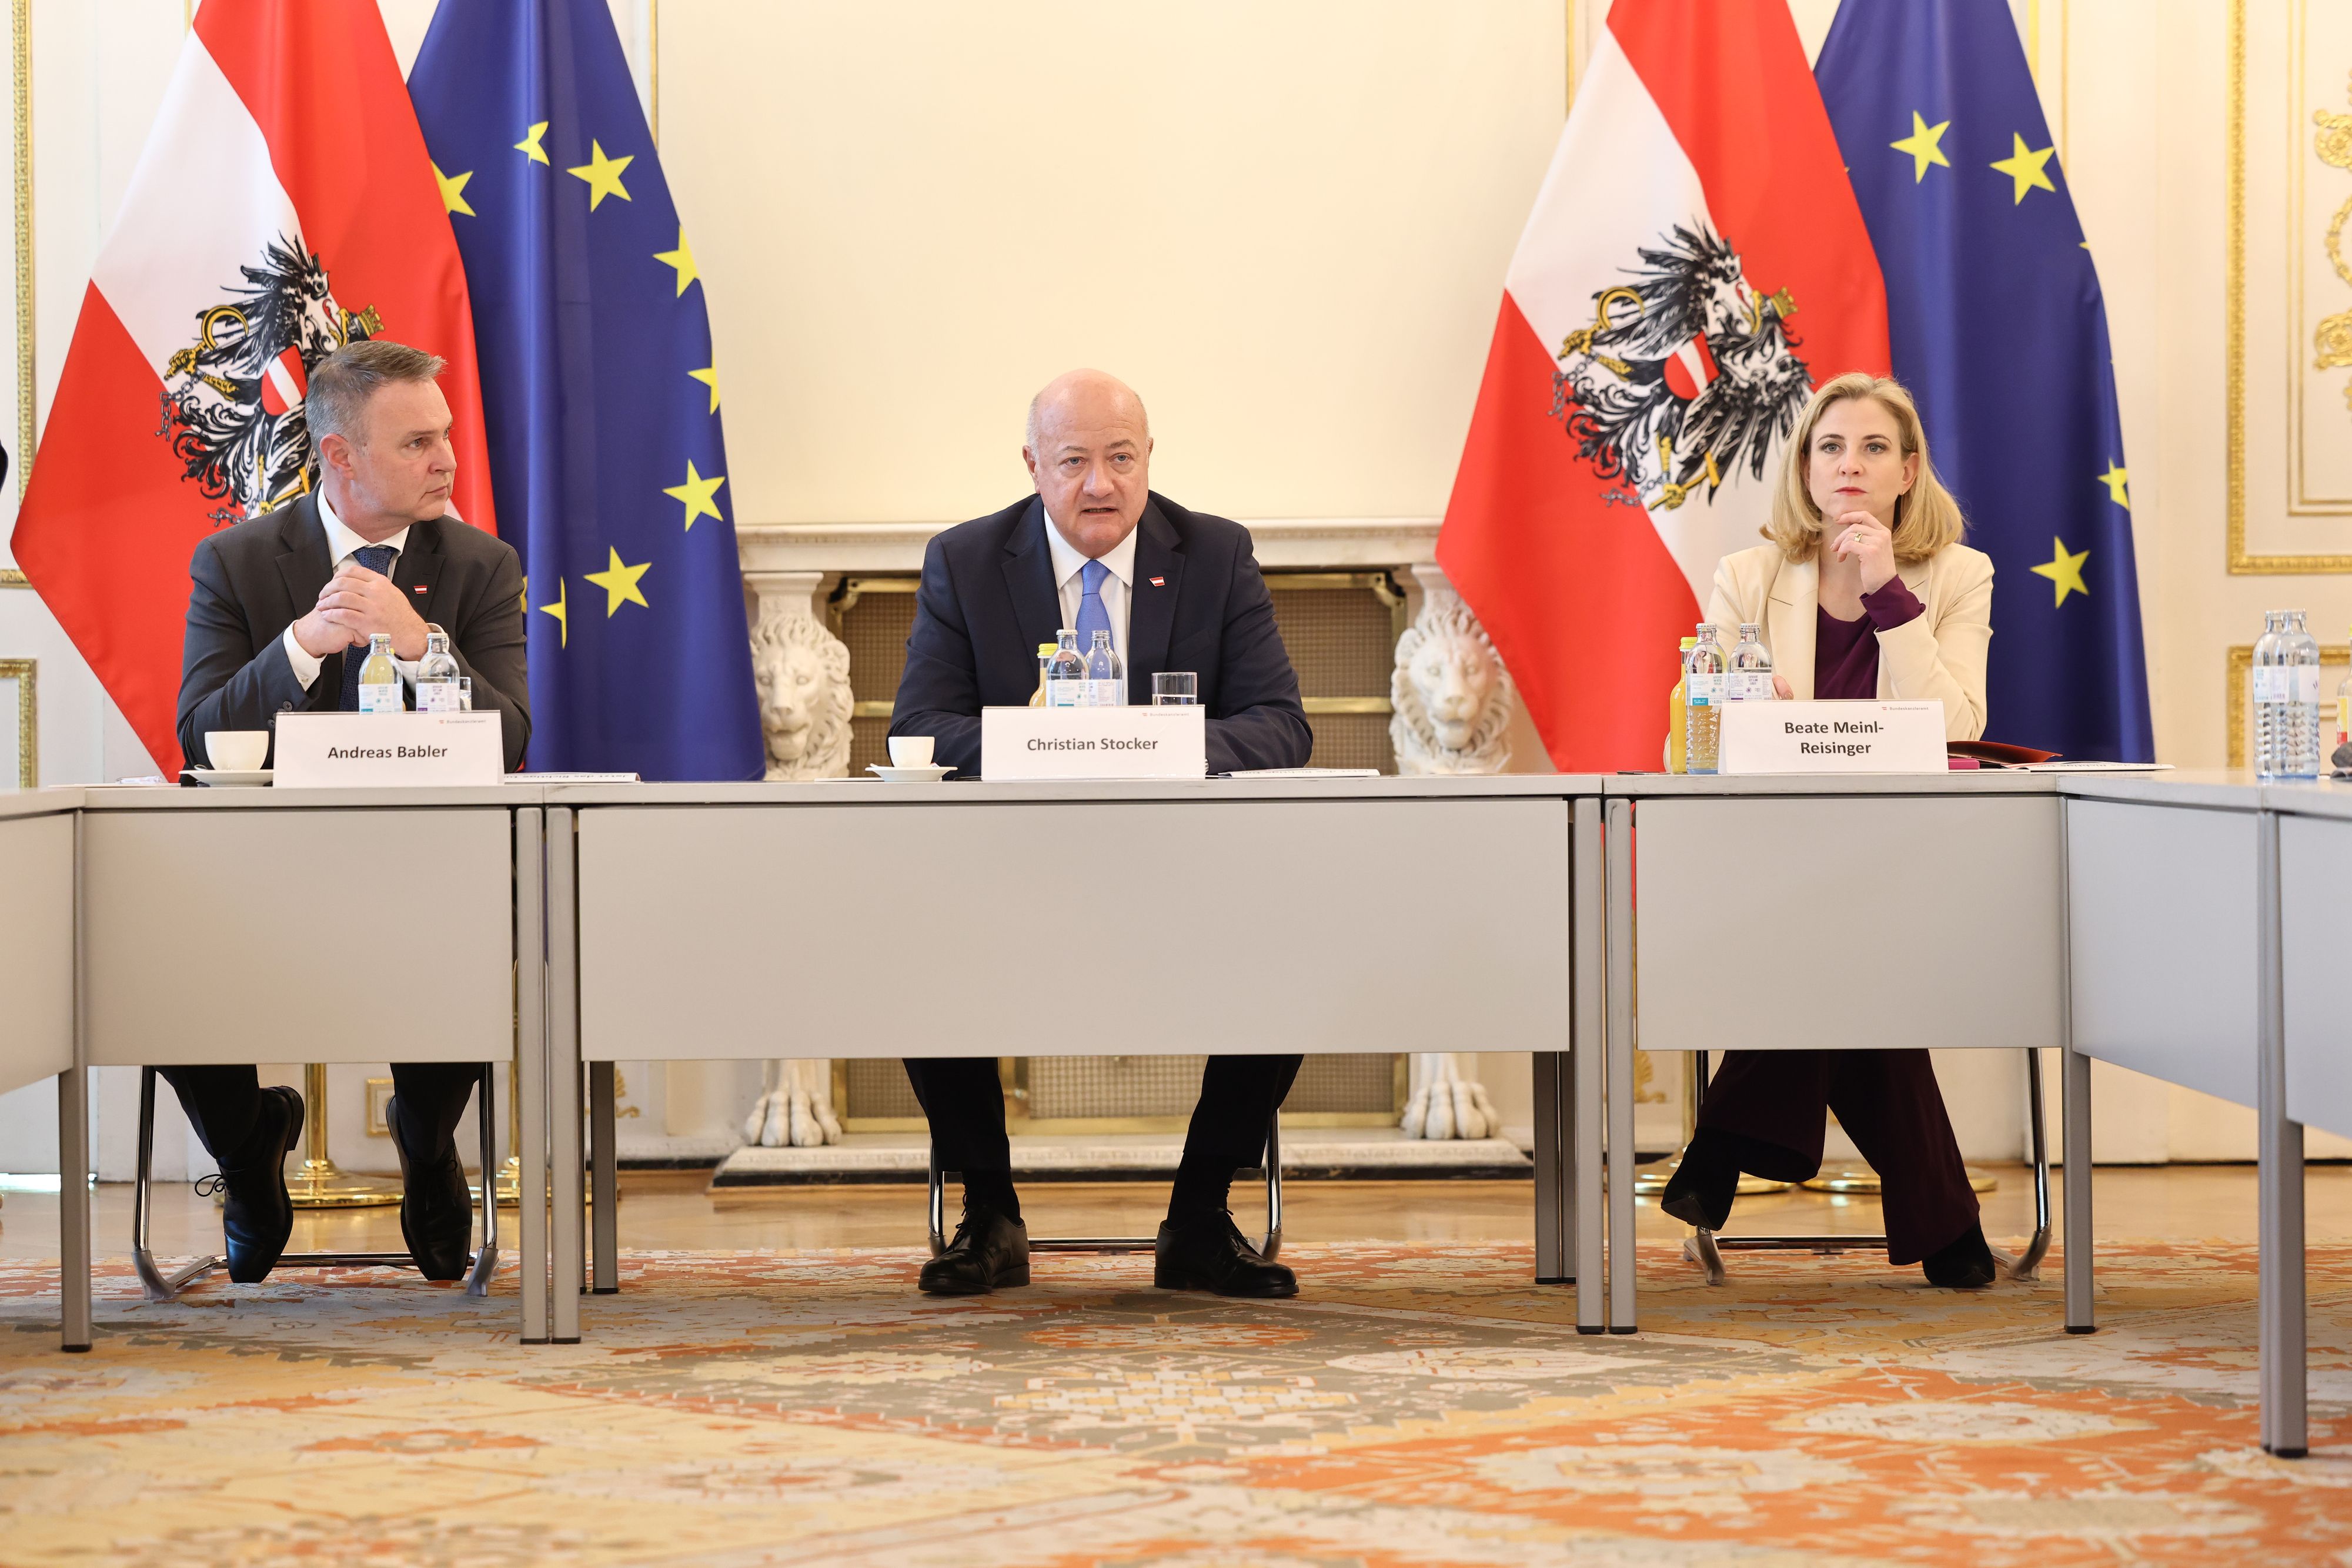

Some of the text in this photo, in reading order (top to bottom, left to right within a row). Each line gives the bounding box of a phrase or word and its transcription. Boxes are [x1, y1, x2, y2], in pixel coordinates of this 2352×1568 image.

[1785, 721, 1884, 734] Beate Meinl-
[1027, 737, 1158, 751] Christian Stocker
[1800, 741, 1872, 757] Reisinger
[328, 745, 448, 759] Andreas Babler
